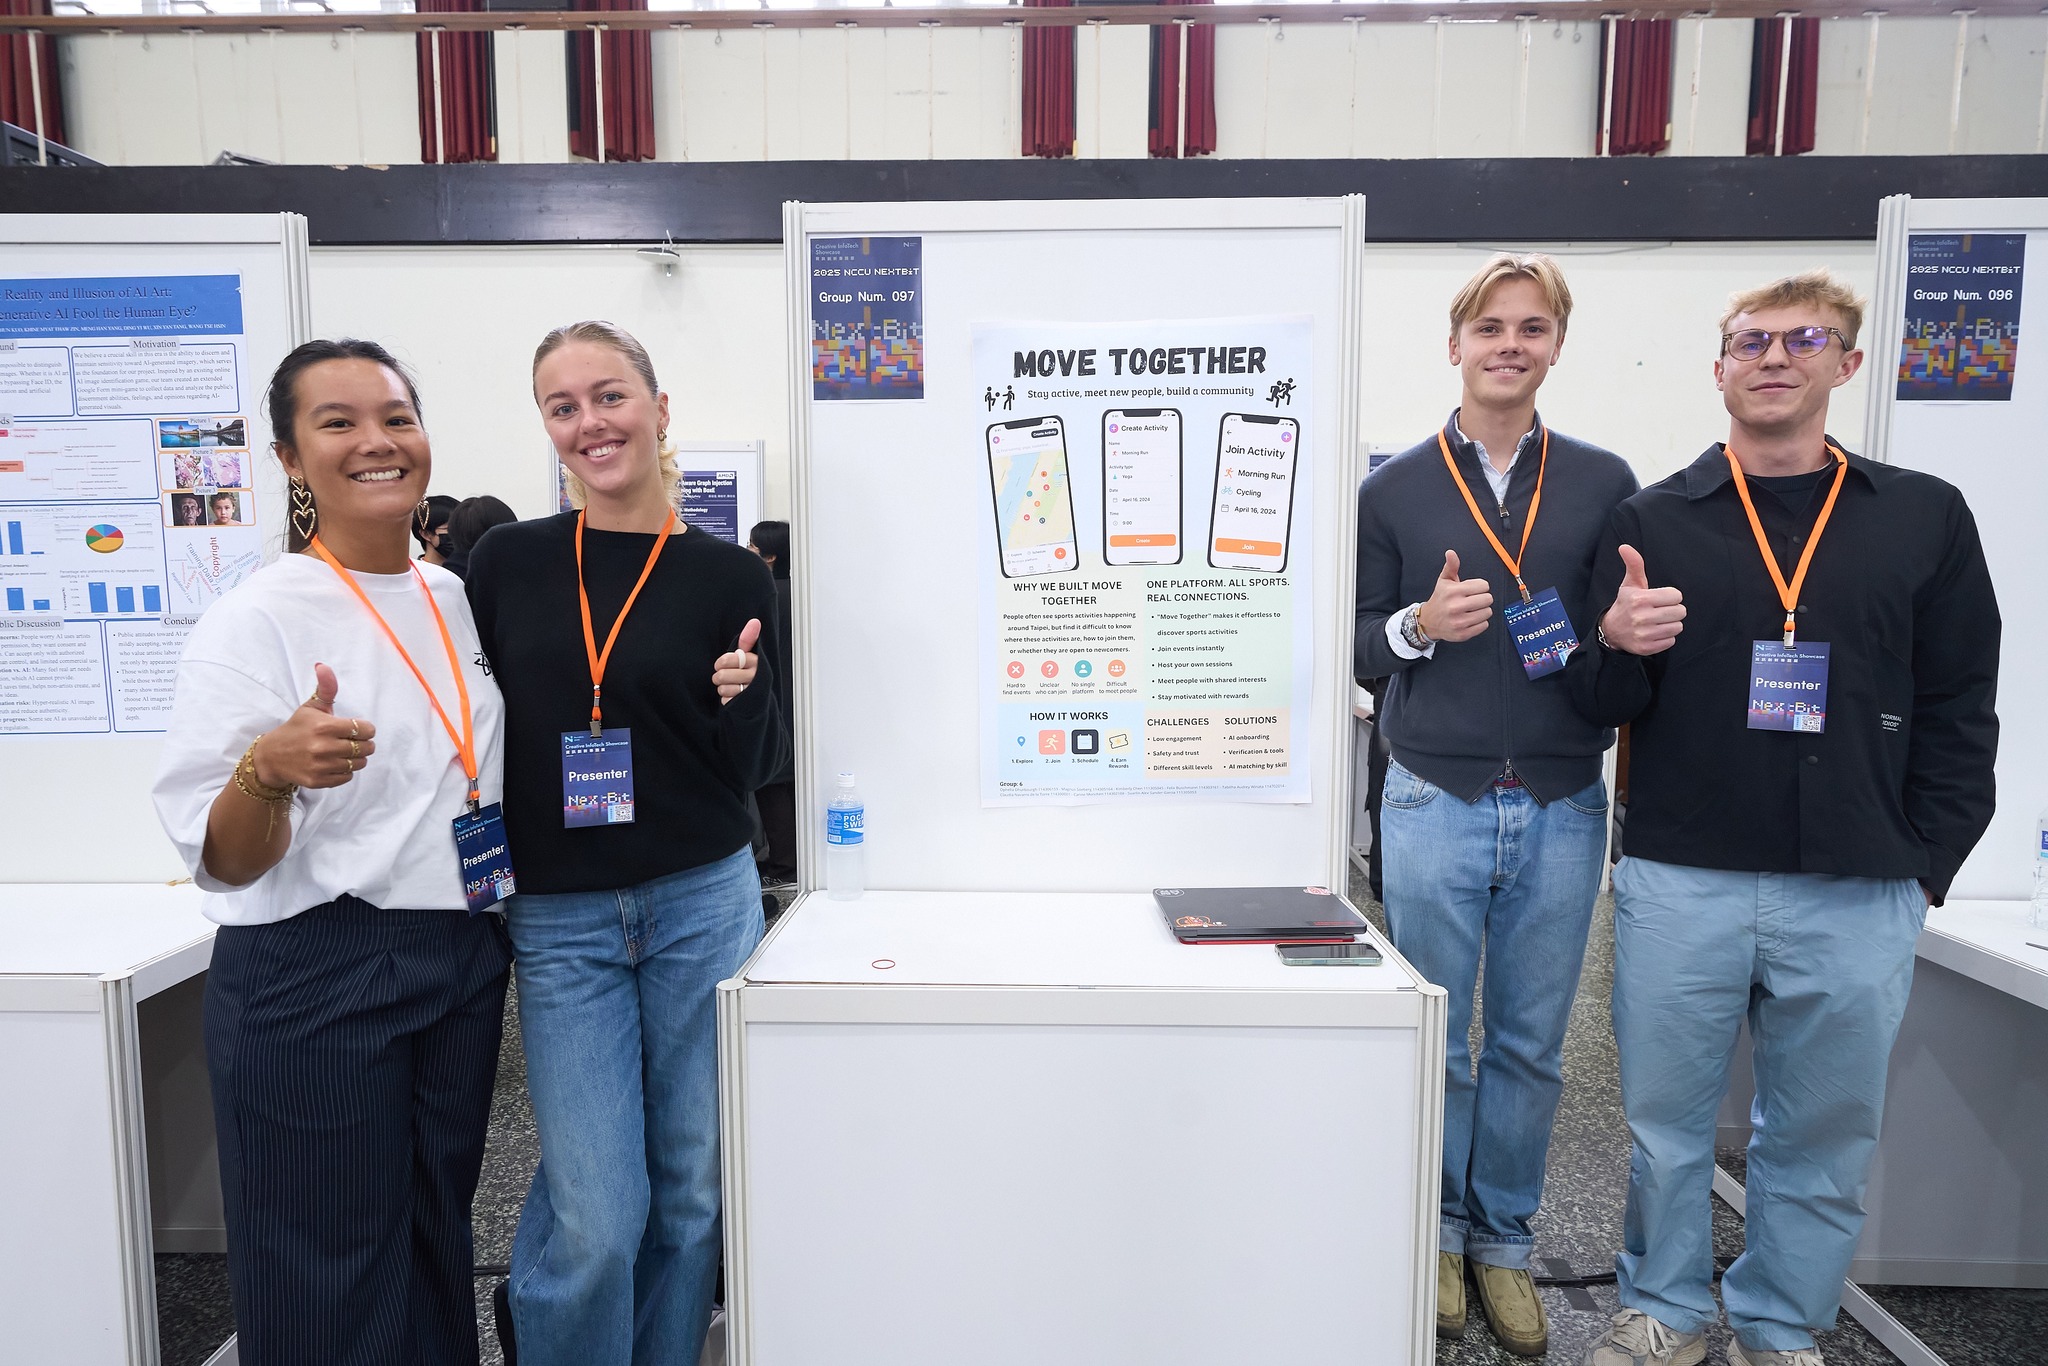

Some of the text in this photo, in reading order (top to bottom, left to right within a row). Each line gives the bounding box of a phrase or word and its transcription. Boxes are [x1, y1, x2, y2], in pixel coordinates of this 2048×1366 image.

[814, 269, 840, 277] 2025
[844, 268, 871, 276] NCCU
[1910, 266, 1938, 274] 2025
[1939, 266, 1971, 274] NCCU
[5, 286, 171, 302] Reality and Illusion of AI Art:
[819, 291, 914, 303] Group Num. 097
[1914, 289, 2012, 301] Group Num. 096
[0, 304, 197, 321] enerative AI Fool the Human Eye?
[133, 340, 177, 349] Motivation
[1014, 346, 1267, 378] MOVE TOGETHER
[1028, 390, 1048, 400] Stay
[1051, 388, 1082, 398] active,
[1131, 387, 1164, 398] people,
[1166, 386, 1190, 395] build
[1200, 386, 1253, 397] community
[1144, 424, 1168, 432] Activity
[1225, 444, 1285, 459] Join Activity
[1238, 469, 1268, 480] Morning
[1236, 488, 1262, 498] Cycling
[186, 542, 214, 583] Training Data
[210, 537, 220, 578] Copyright
[1013, 581, 1121, 591] WHY WE BUILT MOVE
[1146, 580, 1167, 588] ONE
[1170, 579, 1225, 588] PLATFORM.
[1249, 578, 1289, 586] SPORTS.
[1041, 596, 1096, 605] TOGETHER
[1174, 592, 1249, 601] CONNECTIONS.
[0, 619, 60, 629] blic Discussion
[164, 617, 198, 625] Conclus
[1517, 620, 1565, 644] Presenter
[1755, 677, 1821, 691] Presenter
[1030, 711, 1108, 720] HOW IT WORKS
[1224, 716, 1277, 725] SOLUTIONS
[1147, 718, 1208, 726] CHALLENGES
[569, 770, 628, 782] Presenter
[463, 845, 505, 869] Presenter
